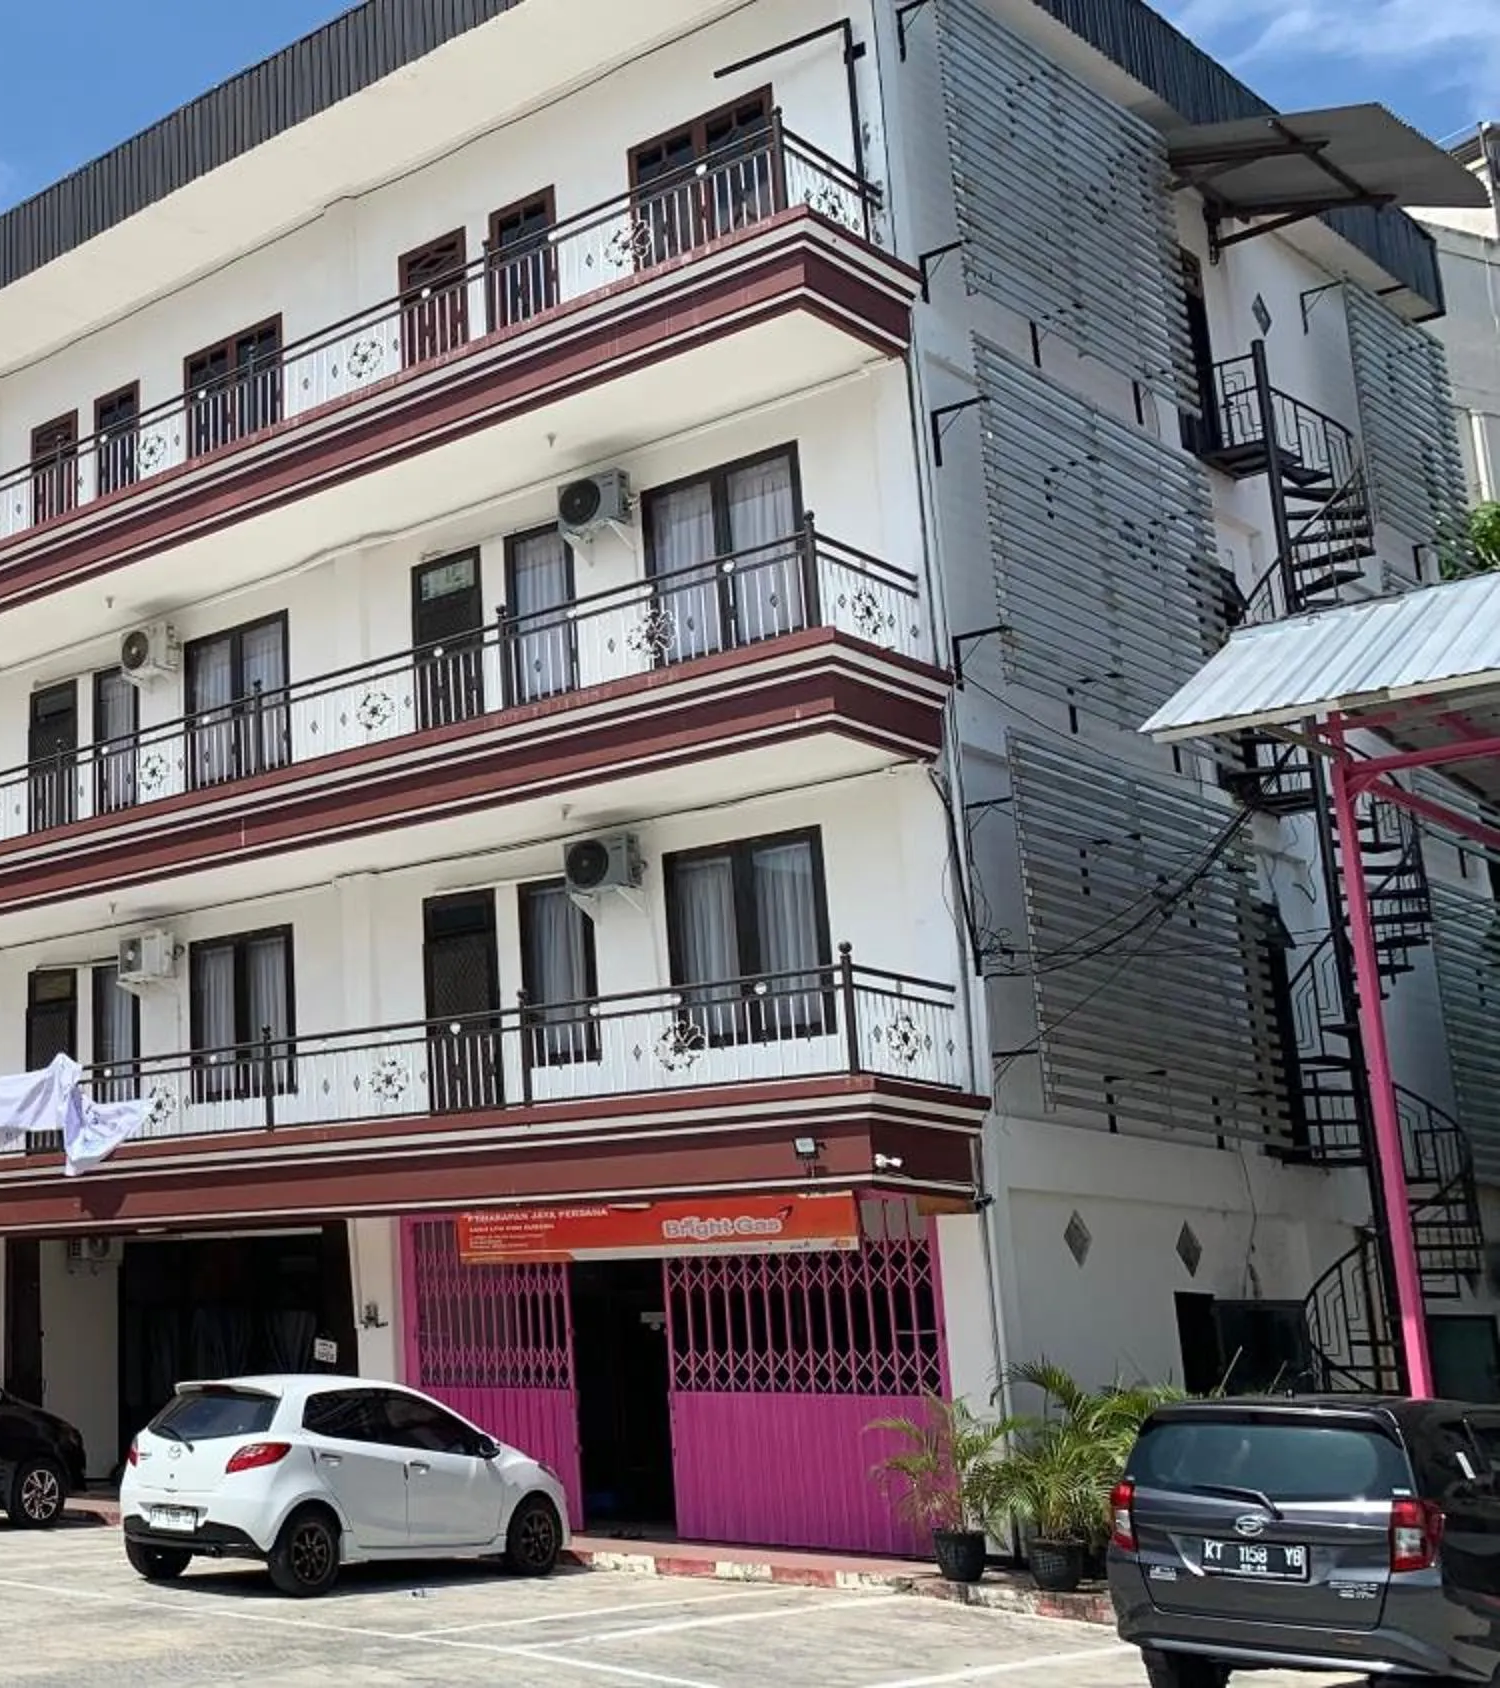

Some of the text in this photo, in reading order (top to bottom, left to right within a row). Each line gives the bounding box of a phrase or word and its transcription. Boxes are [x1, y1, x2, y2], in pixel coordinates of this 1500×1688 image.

[663, 1215, 782, 1241] Bright Gas
[1204, 1539, 1223, 1560] KT
[1240, 1546, 1267, 1563] 1158
